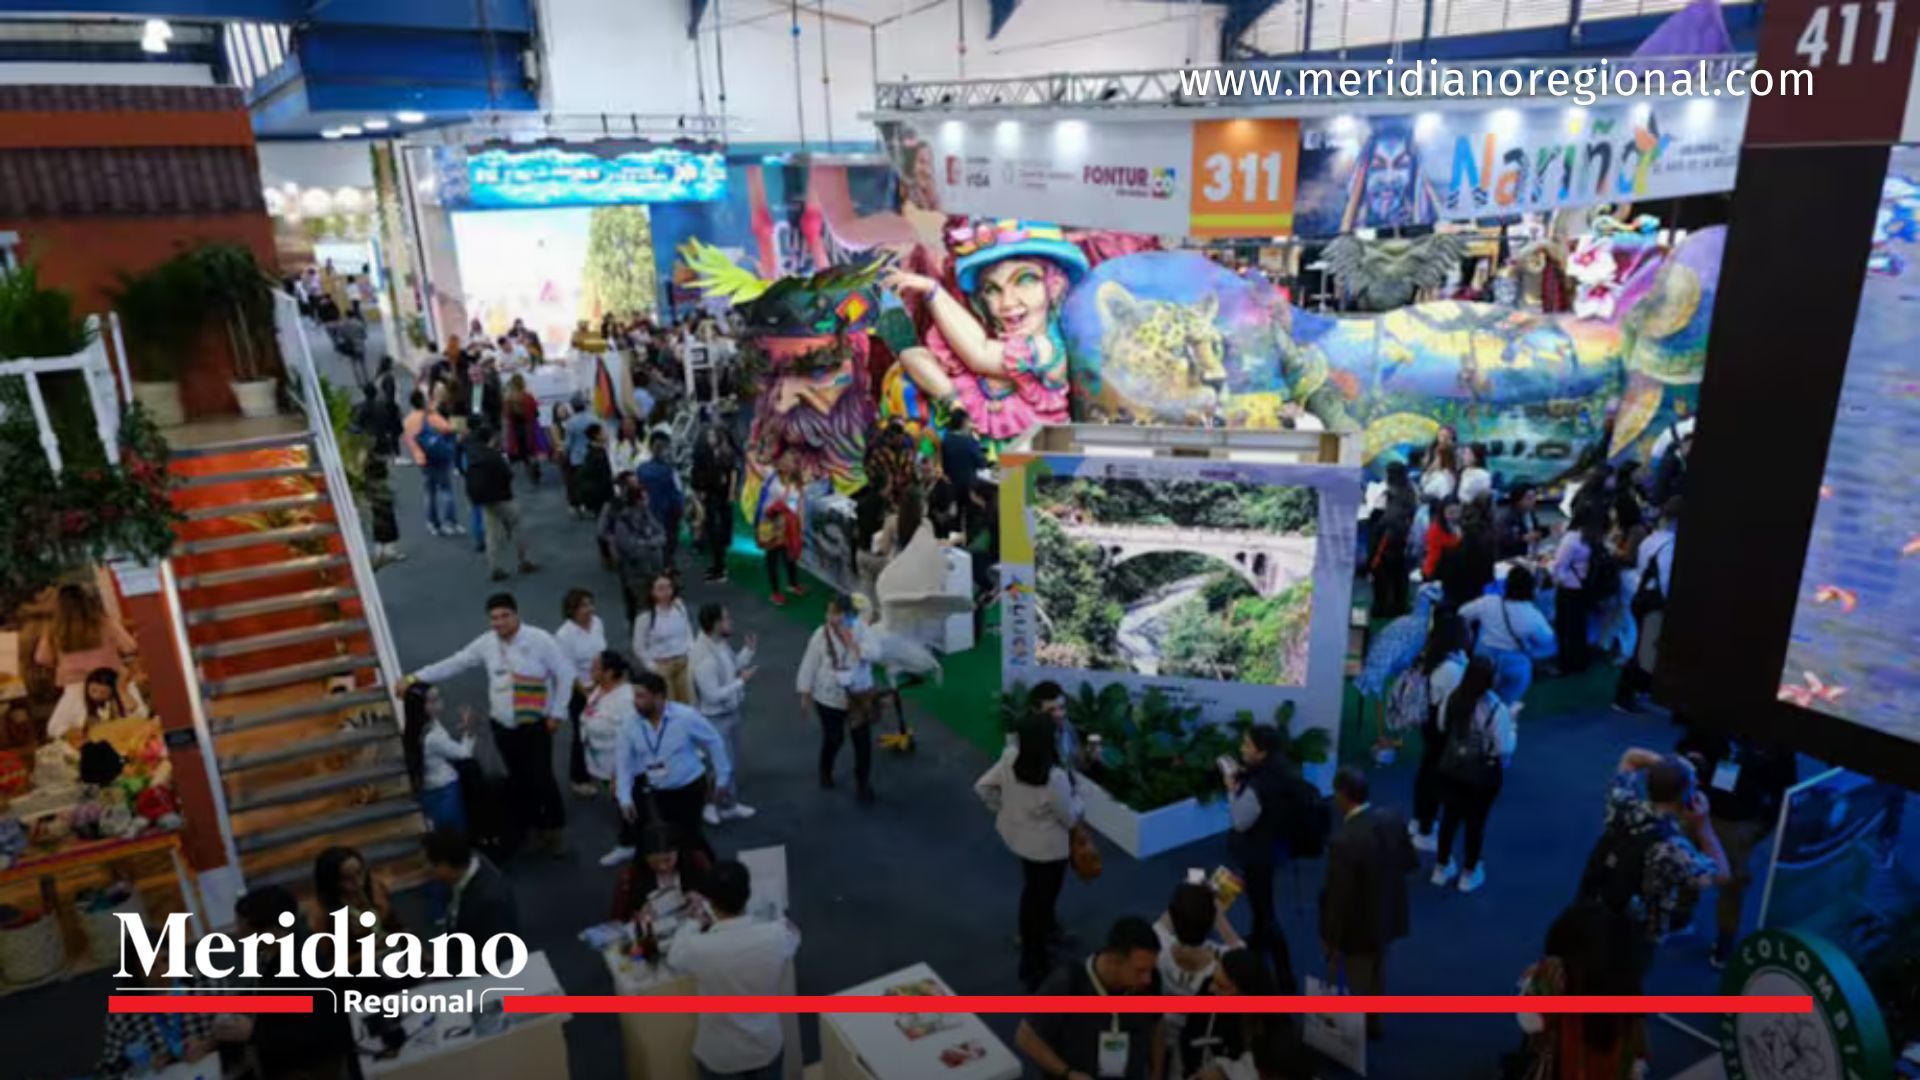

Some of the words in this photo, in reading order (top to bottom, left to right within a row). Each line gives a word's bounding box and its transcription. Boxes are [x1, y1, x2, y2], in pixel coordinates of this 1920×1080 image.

[1796, 0, 1896, 67] 411
[1083, 164, 1149, 187] FONTUR
[1203, 152, 1281, 203] 311
